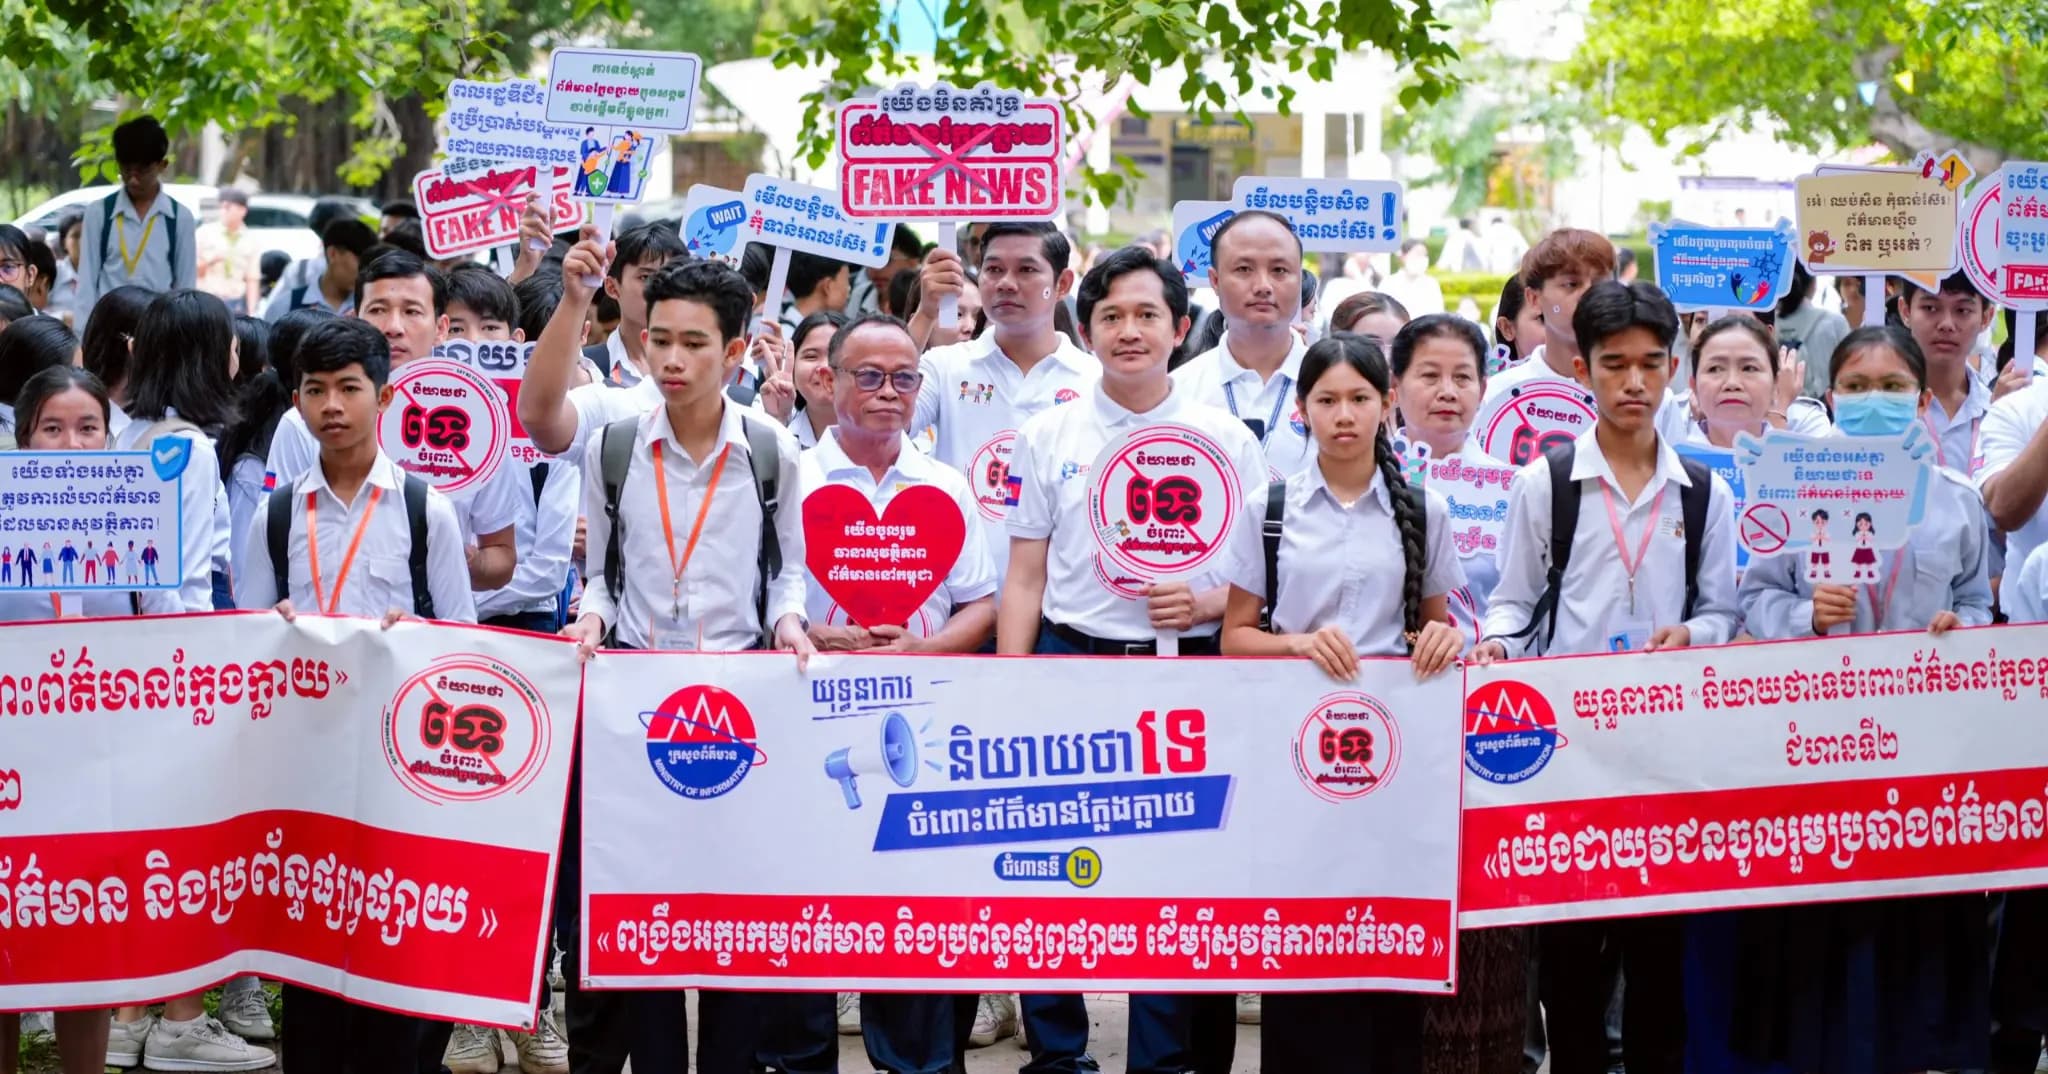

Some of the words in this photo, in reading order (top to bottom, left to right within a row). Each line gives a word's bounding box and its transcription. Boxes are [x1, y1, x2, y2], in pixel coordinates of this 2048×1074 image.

[881, 88, 1020, 118] យើងមិនគាំទ្រ
[854, 168, 935, 206] FAKE
[945, 167, 1047, 206] NEWS
[500, 192, 573, 232] NS
[711, 206, 743, 225] WAIT
[401, 402, 472, 450] ទេ
[12, 459, 144, 483] យើងទាំងអស់គ្នា
[1126, 475, 1202, 526] ទេ
[812, 674, 913, 713] យុទ្ធនាការ
[1573, 682, 1684, 730] យុទ្ធនាការ
[420, 698, 508, 757] ទេ
[1785, 715, 1898, 768] ជំហានទី២
[654, 758, 688, 793] MINISTRY
[686, 786, 698, 796] OF
[700, 759, 750, 797] INFORMATION
[1482, 781, 2048, 885] «យើងជាយុវជនចូលរួមប្រឆាំងព័ត៌មាន
[616, 901, 886, 967] ពង្រឹងអក្ខរកម្មព័ត៌មាន
[894, 904, 1138, 969] និងប្រព័ន្ធផ្សព្វផ្សាយ
[1146, 903, 1426, 970] ដើម្បីសុវត្ថិភាពព័ត៌មាន
